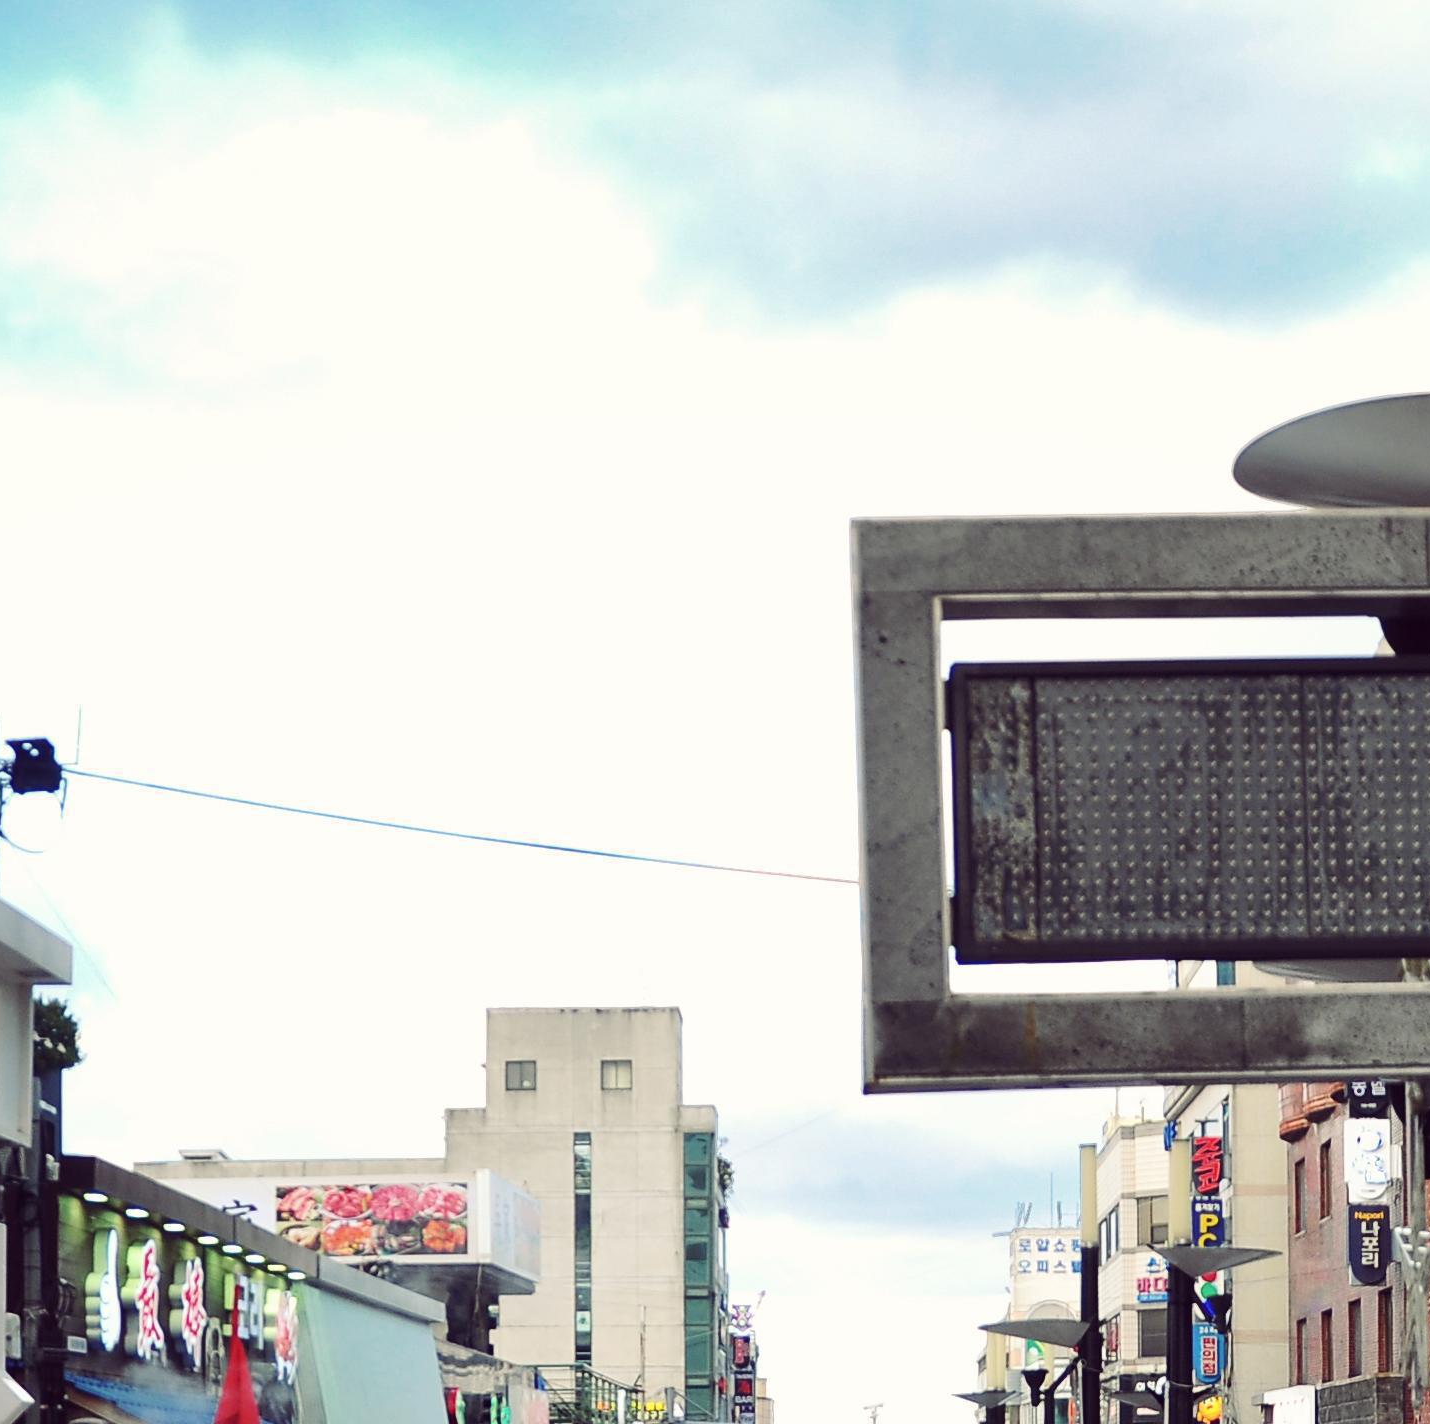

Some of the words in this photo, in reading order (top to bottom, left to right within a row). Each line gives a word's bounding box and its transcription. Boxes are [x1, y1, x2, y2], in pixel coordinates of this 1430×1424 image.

[1354, 1210, 1385, 1221] Napori
[1359, 1220, 1382, 1270] 나포리
[1202, 1337, 1216, 1376] 편의점
